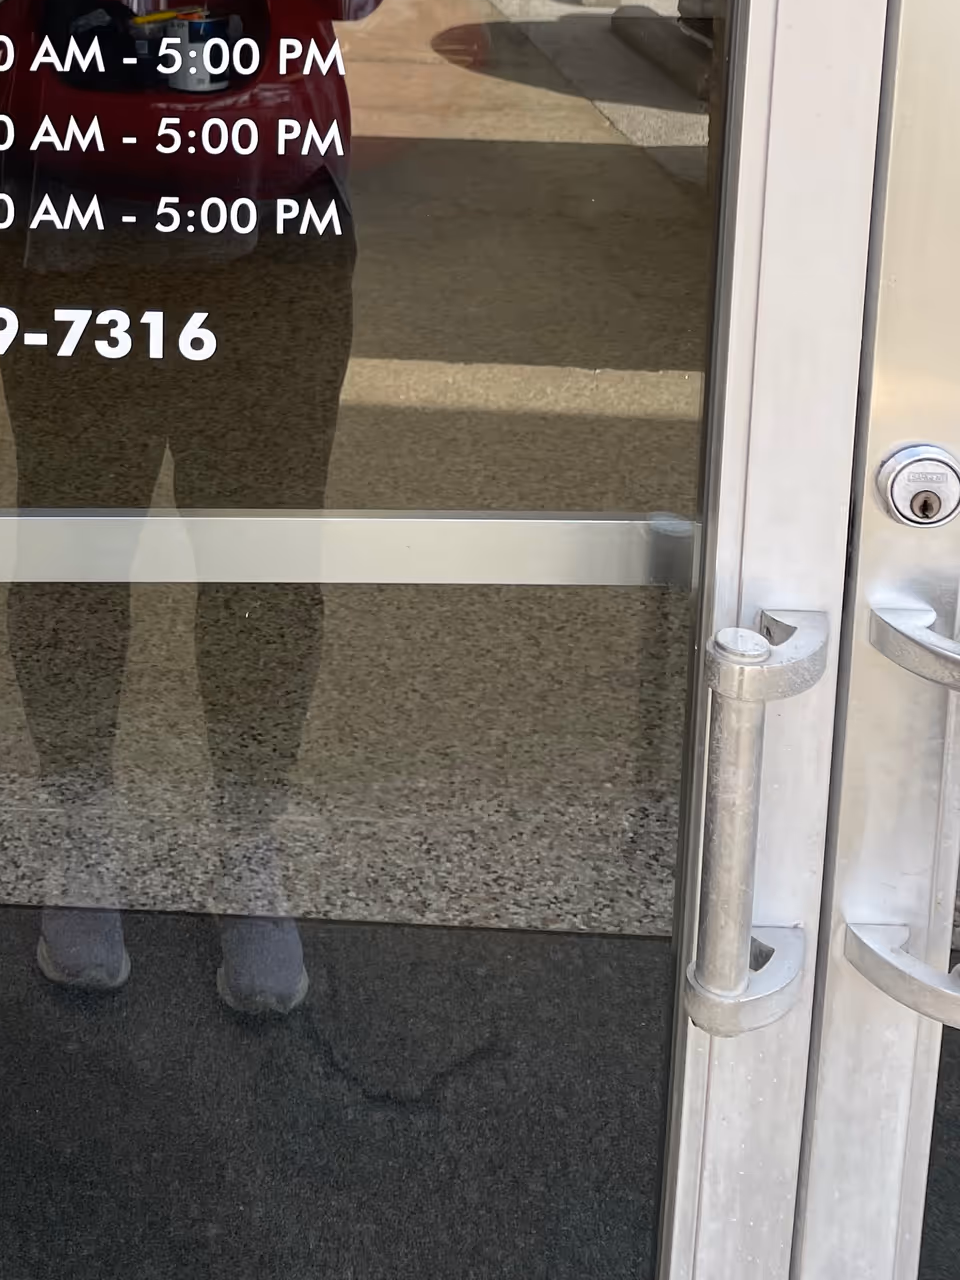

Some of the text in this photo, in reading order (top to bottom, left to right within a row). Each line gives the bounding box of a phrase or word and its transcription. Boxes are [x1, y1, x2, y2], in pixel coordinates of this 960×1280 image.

[29, 34, 106, 73] AM
[156, 37, 260, 75] 5:00
[279, 38, 346, 76] PM
[29, 113, 106, 152] AM
[155, 117, 259, 155] 5:00
[278, 118, 344, 156] PM
[29, 192, 106, 230] AM
[155, 196, 257, 234] 5:00
[276, 198, 342, 236] PM
